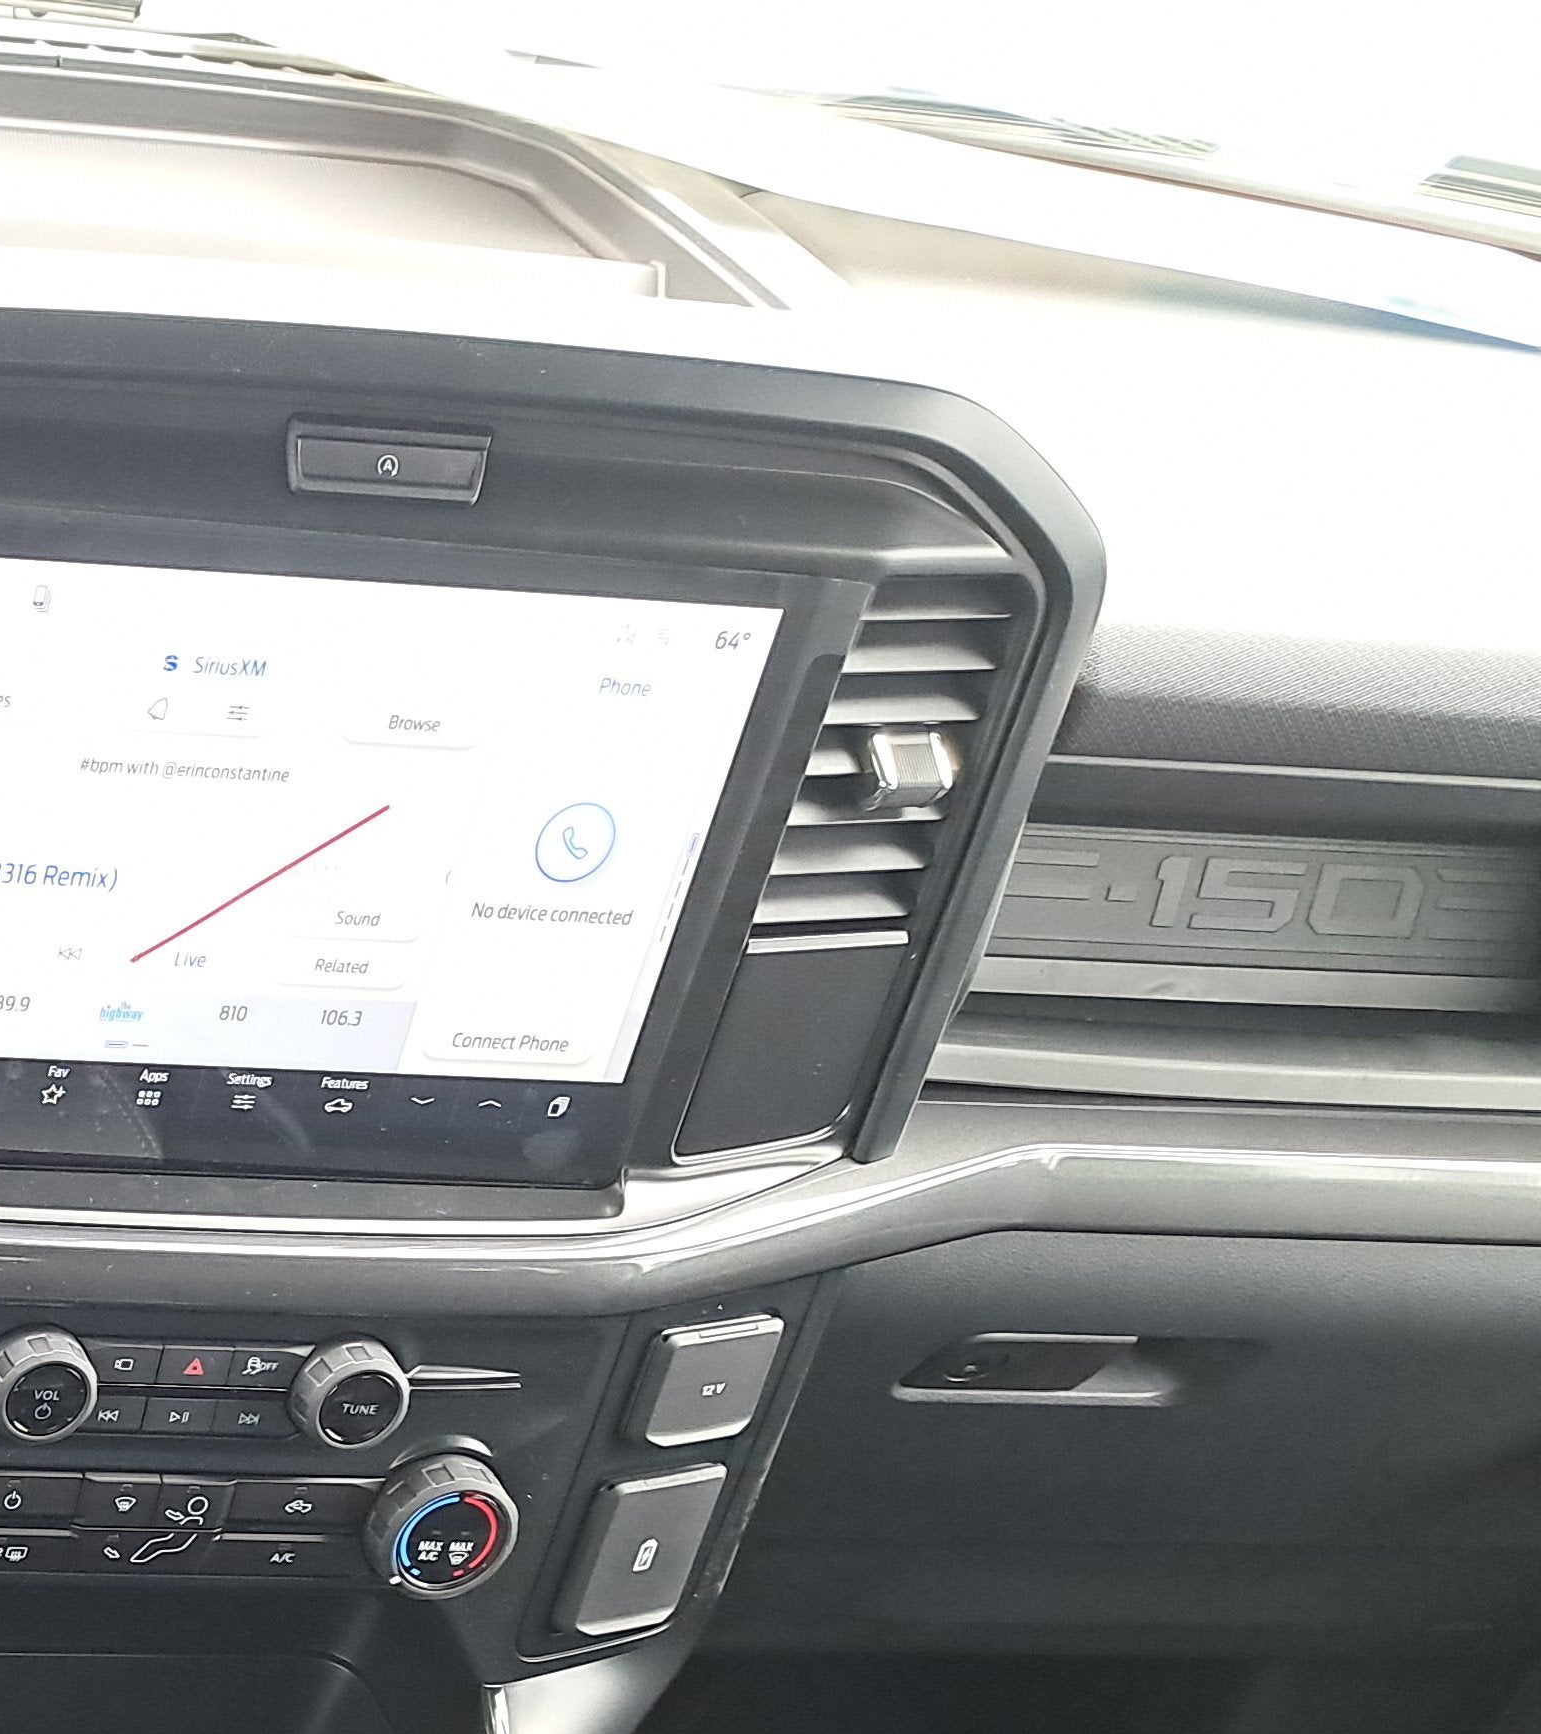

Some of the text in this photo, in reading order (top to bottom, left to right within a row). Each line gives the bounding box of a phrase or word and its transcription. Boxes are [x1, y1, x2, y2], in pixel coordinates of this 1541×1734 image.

[714, 630, 752, 651] 64°
[192, 656, 269, 678] SiriusXM
[599, 677, 653, 698] Phone
[388, 714, 441, 733] Browse
[80, 757, 291, 785] #bpm with @erinconstantine
[42, 864, 119, 894] Remix)
[335, 910, 381, 927] Sound
[471, 902, 635, 927] No device connected
[174, 951, 207, 969] Live
[314, 958, 369, 974] Related
[99, 1004, 146, 1022] highway
[218, 1005, 248, 1022] 810
[320, 1009, 363, 1027] 106.3
[452, 1032, 570, 1053] Connect Phone
[47, 1065, 72, 1078] Fav
[139, 1069, 170, 1085] Apps
[227, 1073, 273, 1088] Settings
[321, 1077, 370, 1091] Features
[259, 1360, 281, 1372] OFF
[34, 1389, 61, 1402] VOL
[341, 1403, 380, 1416] TUNE
[417, 1540, 443, 1552] MAX
[448, 1541, 476, 1552] MAX
[269, 1552, 296, 1565] A/C
